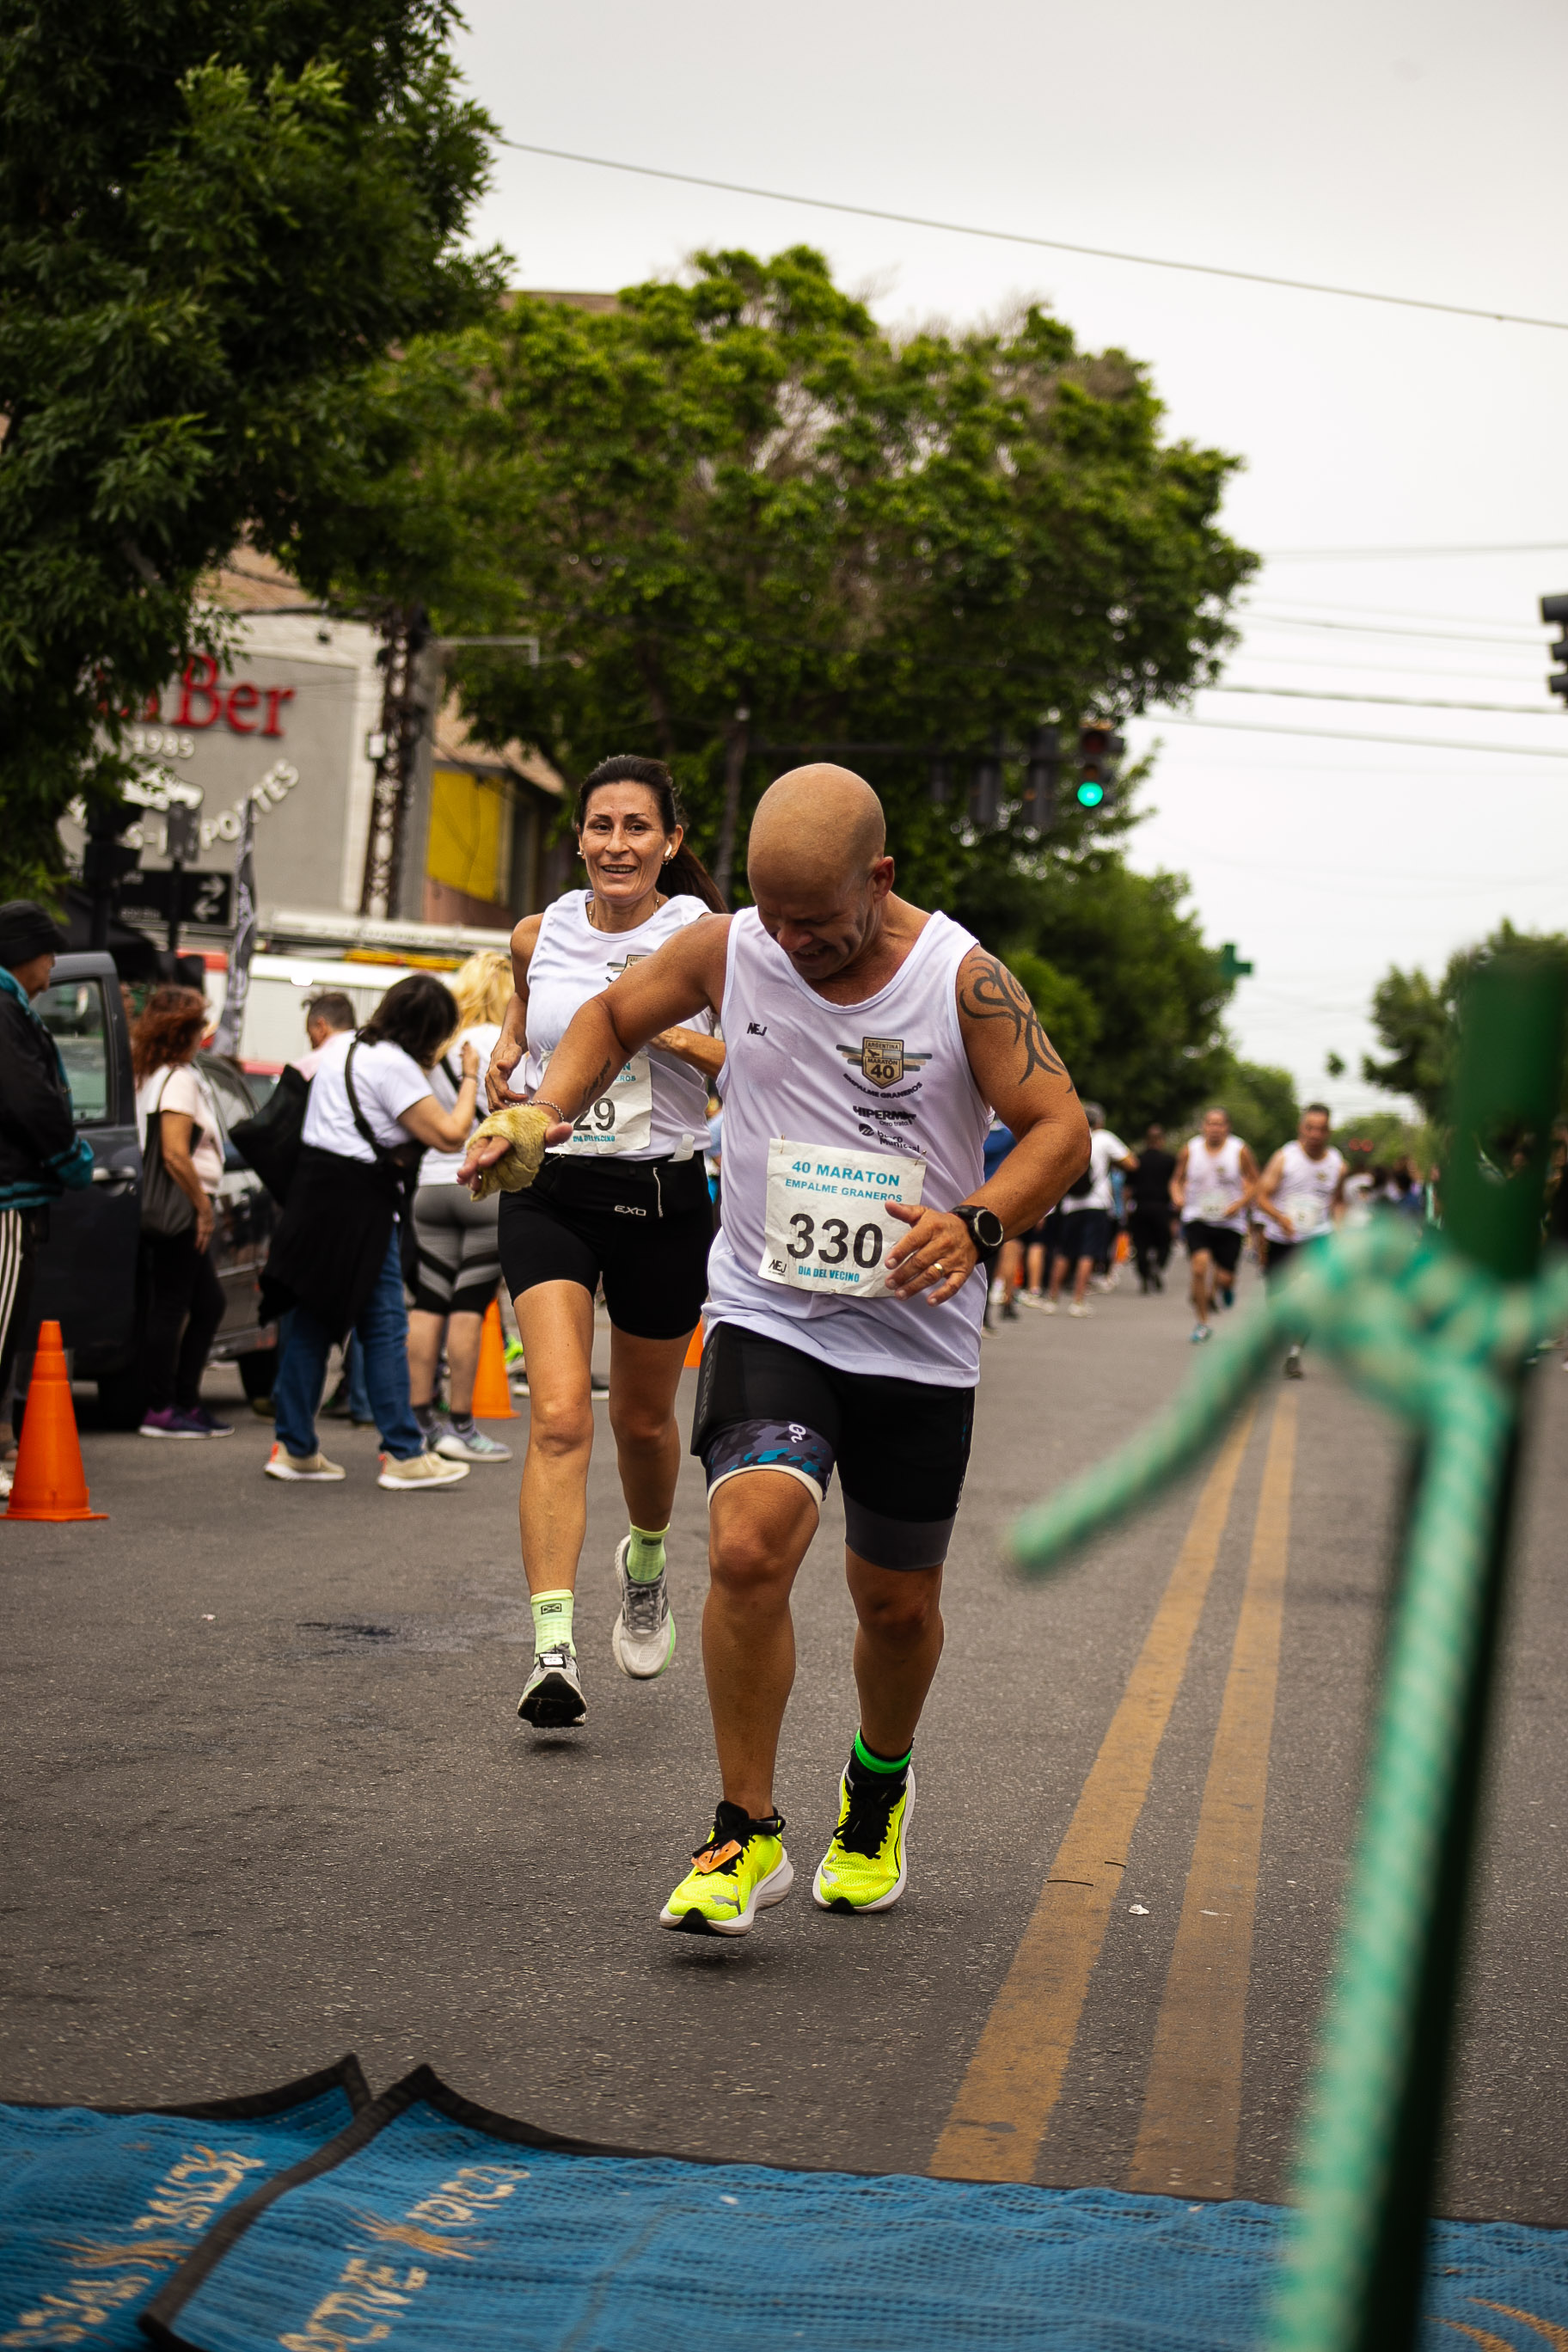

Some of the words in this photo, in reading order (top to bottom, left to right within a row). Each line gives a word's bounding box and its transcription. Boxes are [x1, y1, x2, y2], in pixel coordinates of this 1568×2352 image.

[870, 1064, 895, 1079] 40
[843, 1073, 879, 1097] EMPALME
[880, 1081, 923, 1099] GRANEROS
[792, 1161, 812, 1174] 40
[816, 1163, 900, 1186] MARATON
[785, 1179, 838, 1194] EMPALME
[841, 1187, 903, 1203] GRANEROS
[786, 1213, 884, 1269] 330
[798, 1265, 812, 1277] DIA
[812, 1268, 827, 1278] DEL
[829, 1270, 861, 1283] VECINO
